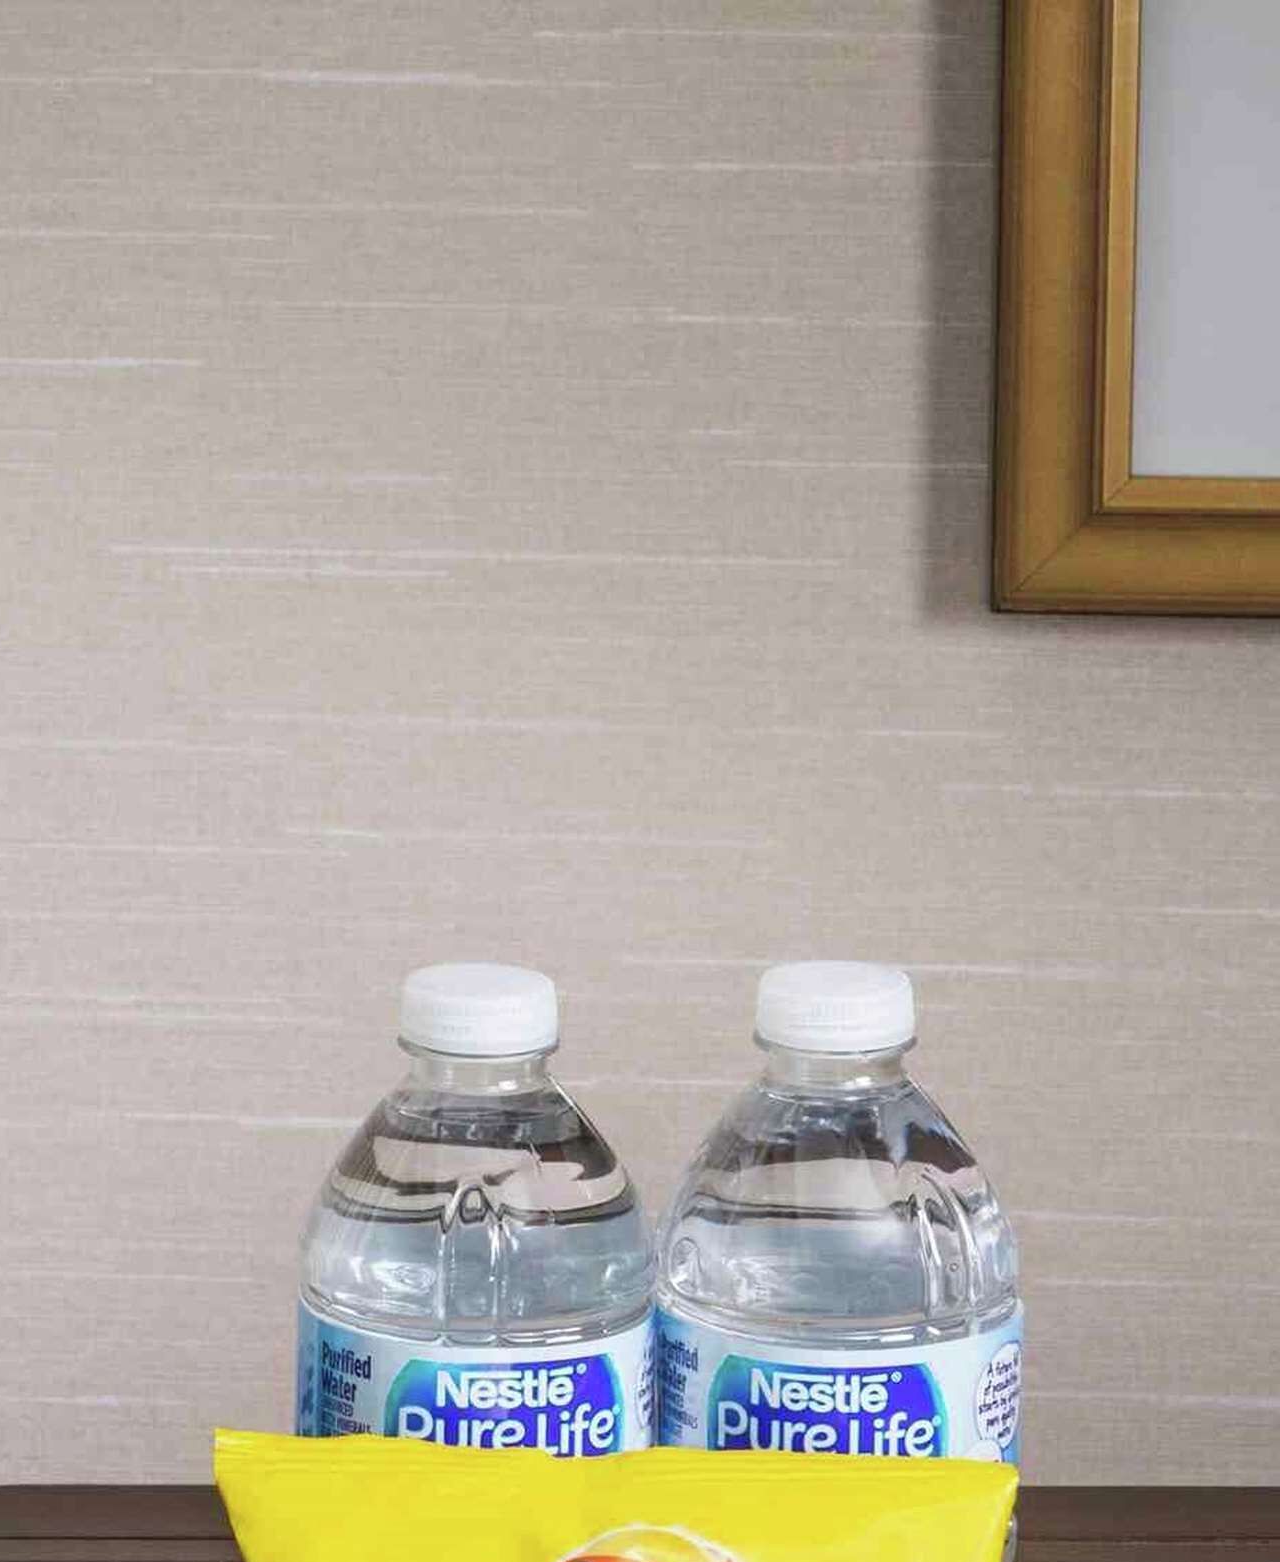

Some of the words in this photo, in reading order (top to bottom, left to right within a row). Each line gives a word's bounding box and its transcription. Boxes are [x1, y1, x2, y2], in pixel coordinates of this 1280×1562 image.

[321, 1339, 372, 1380] Purified
[321, 1366, 357, 1402] Water
[398, 1405, 526, 1450] Pure
[537, 1403, 615, 1457] Life
[716, 1401, 838, 1455] Pure
[849, 1411, 936, 1457] Life
